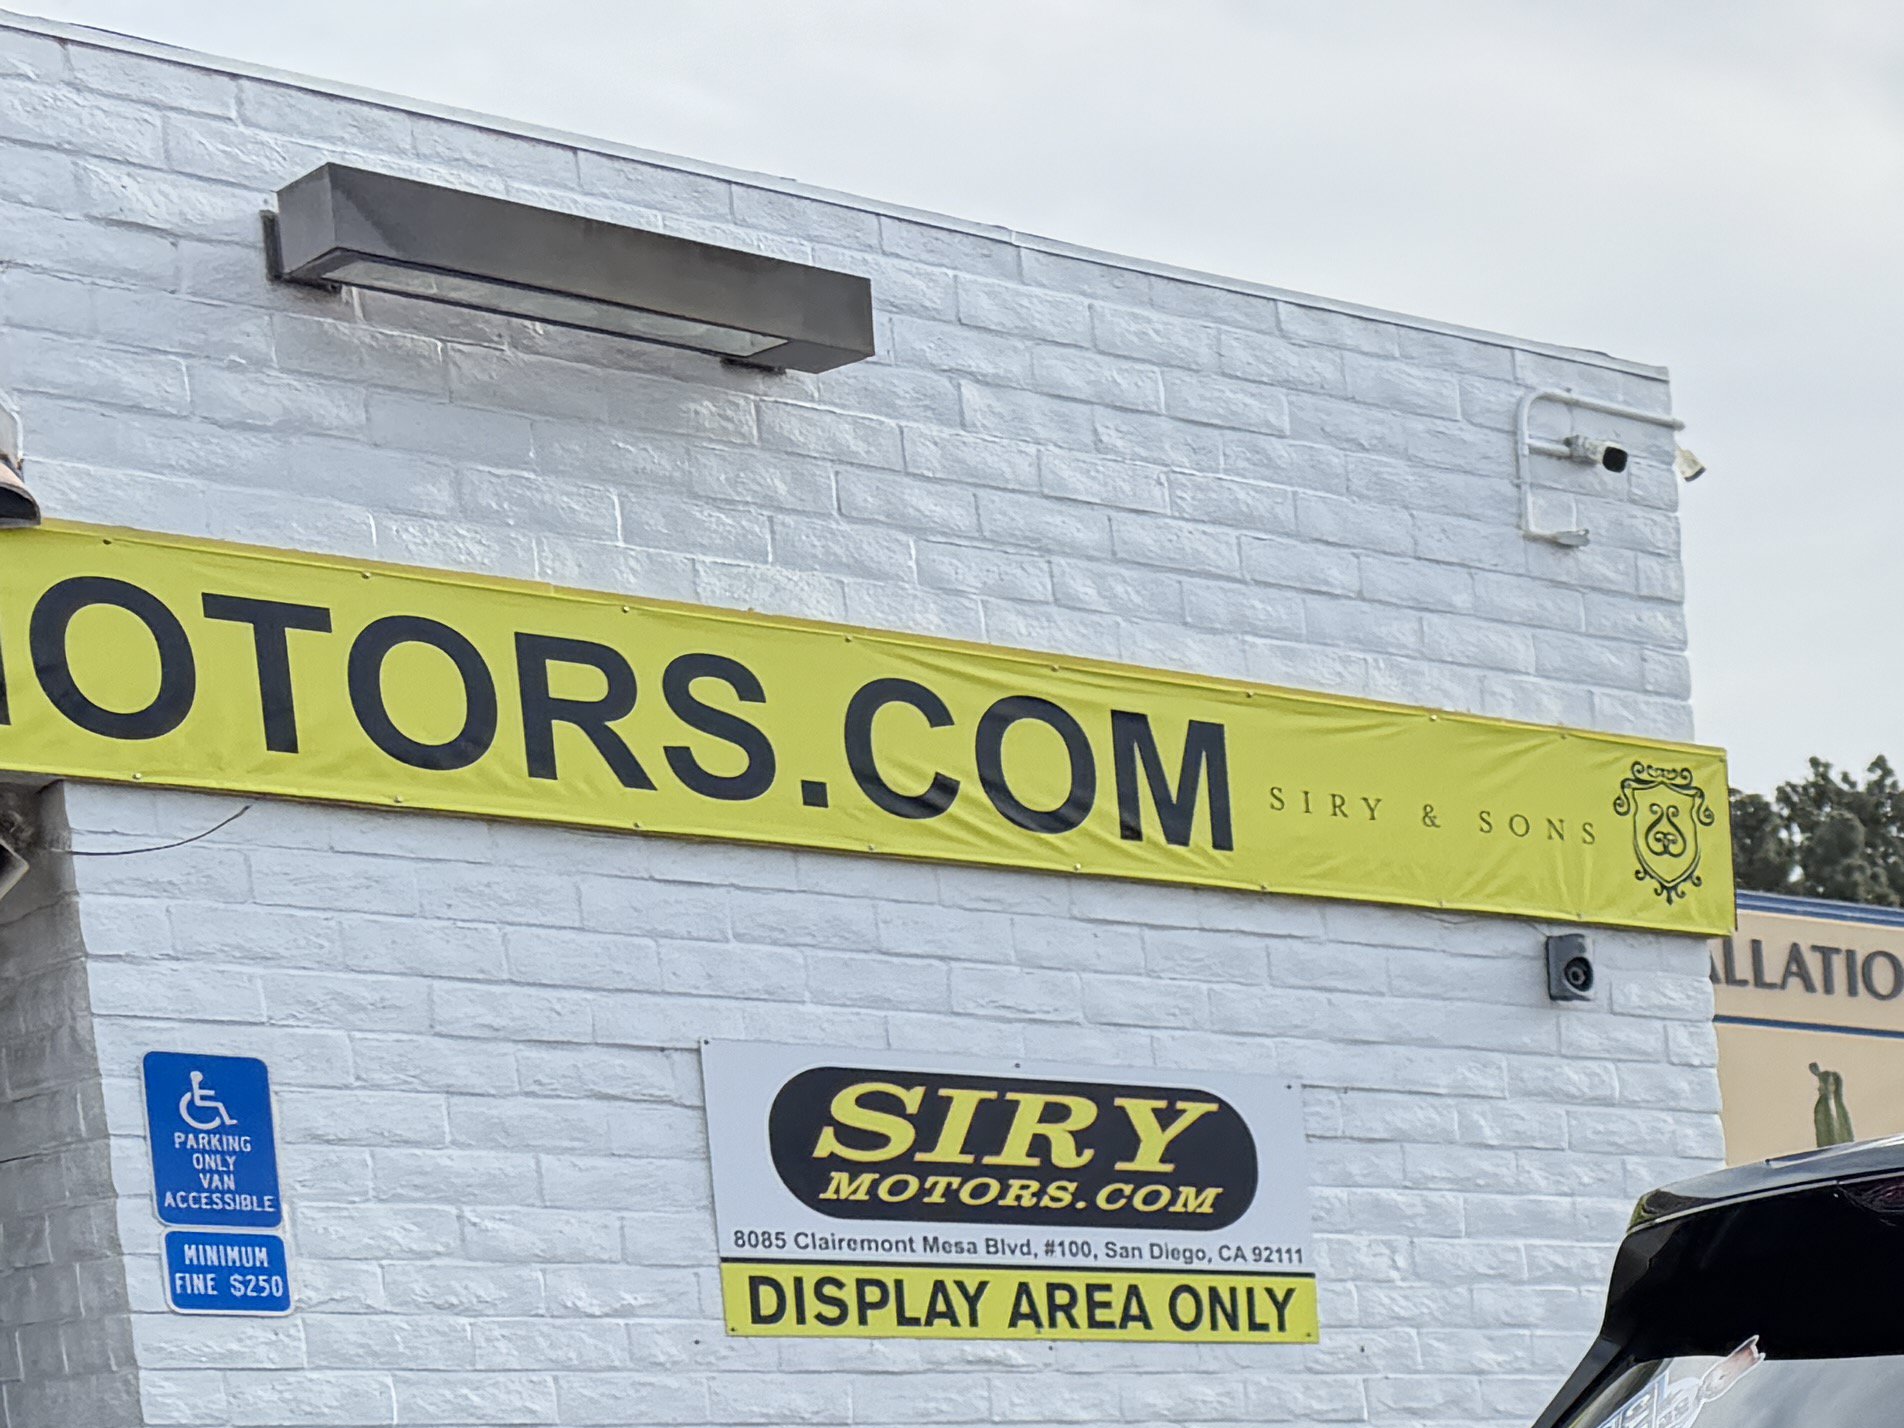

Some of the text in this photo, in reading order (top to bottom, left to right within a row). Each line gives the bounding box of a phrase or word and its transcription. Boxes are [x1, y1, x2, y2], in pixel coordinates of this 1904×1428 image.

[0, 574, 1233, 852] OTORS.COM
[1270, 784, 1597, 845] SIRY & SONS
[174, 1132, 252, 1152] PARKING
[812, 1080, 1219, 1174] SIRY
[192, 1153, 237, 1173] ONLY
[199, 1173, 236, 1191] VAN
[818, 1171, 1224, 1215] MOTORS.COM
[164, 1191, 276, 1212] ACCESSIBLE
[184, 1244, 269, 1268] MINIMUM
[734, 1230, 1304, 1265] 8085 Clairemont Mesa Blvd, #100, San Diego, CA 92111
[175, 1273, 284, 1298] FINE $250
[747, 1275, 1297, 1334] DISPLAY AREA ONLY
